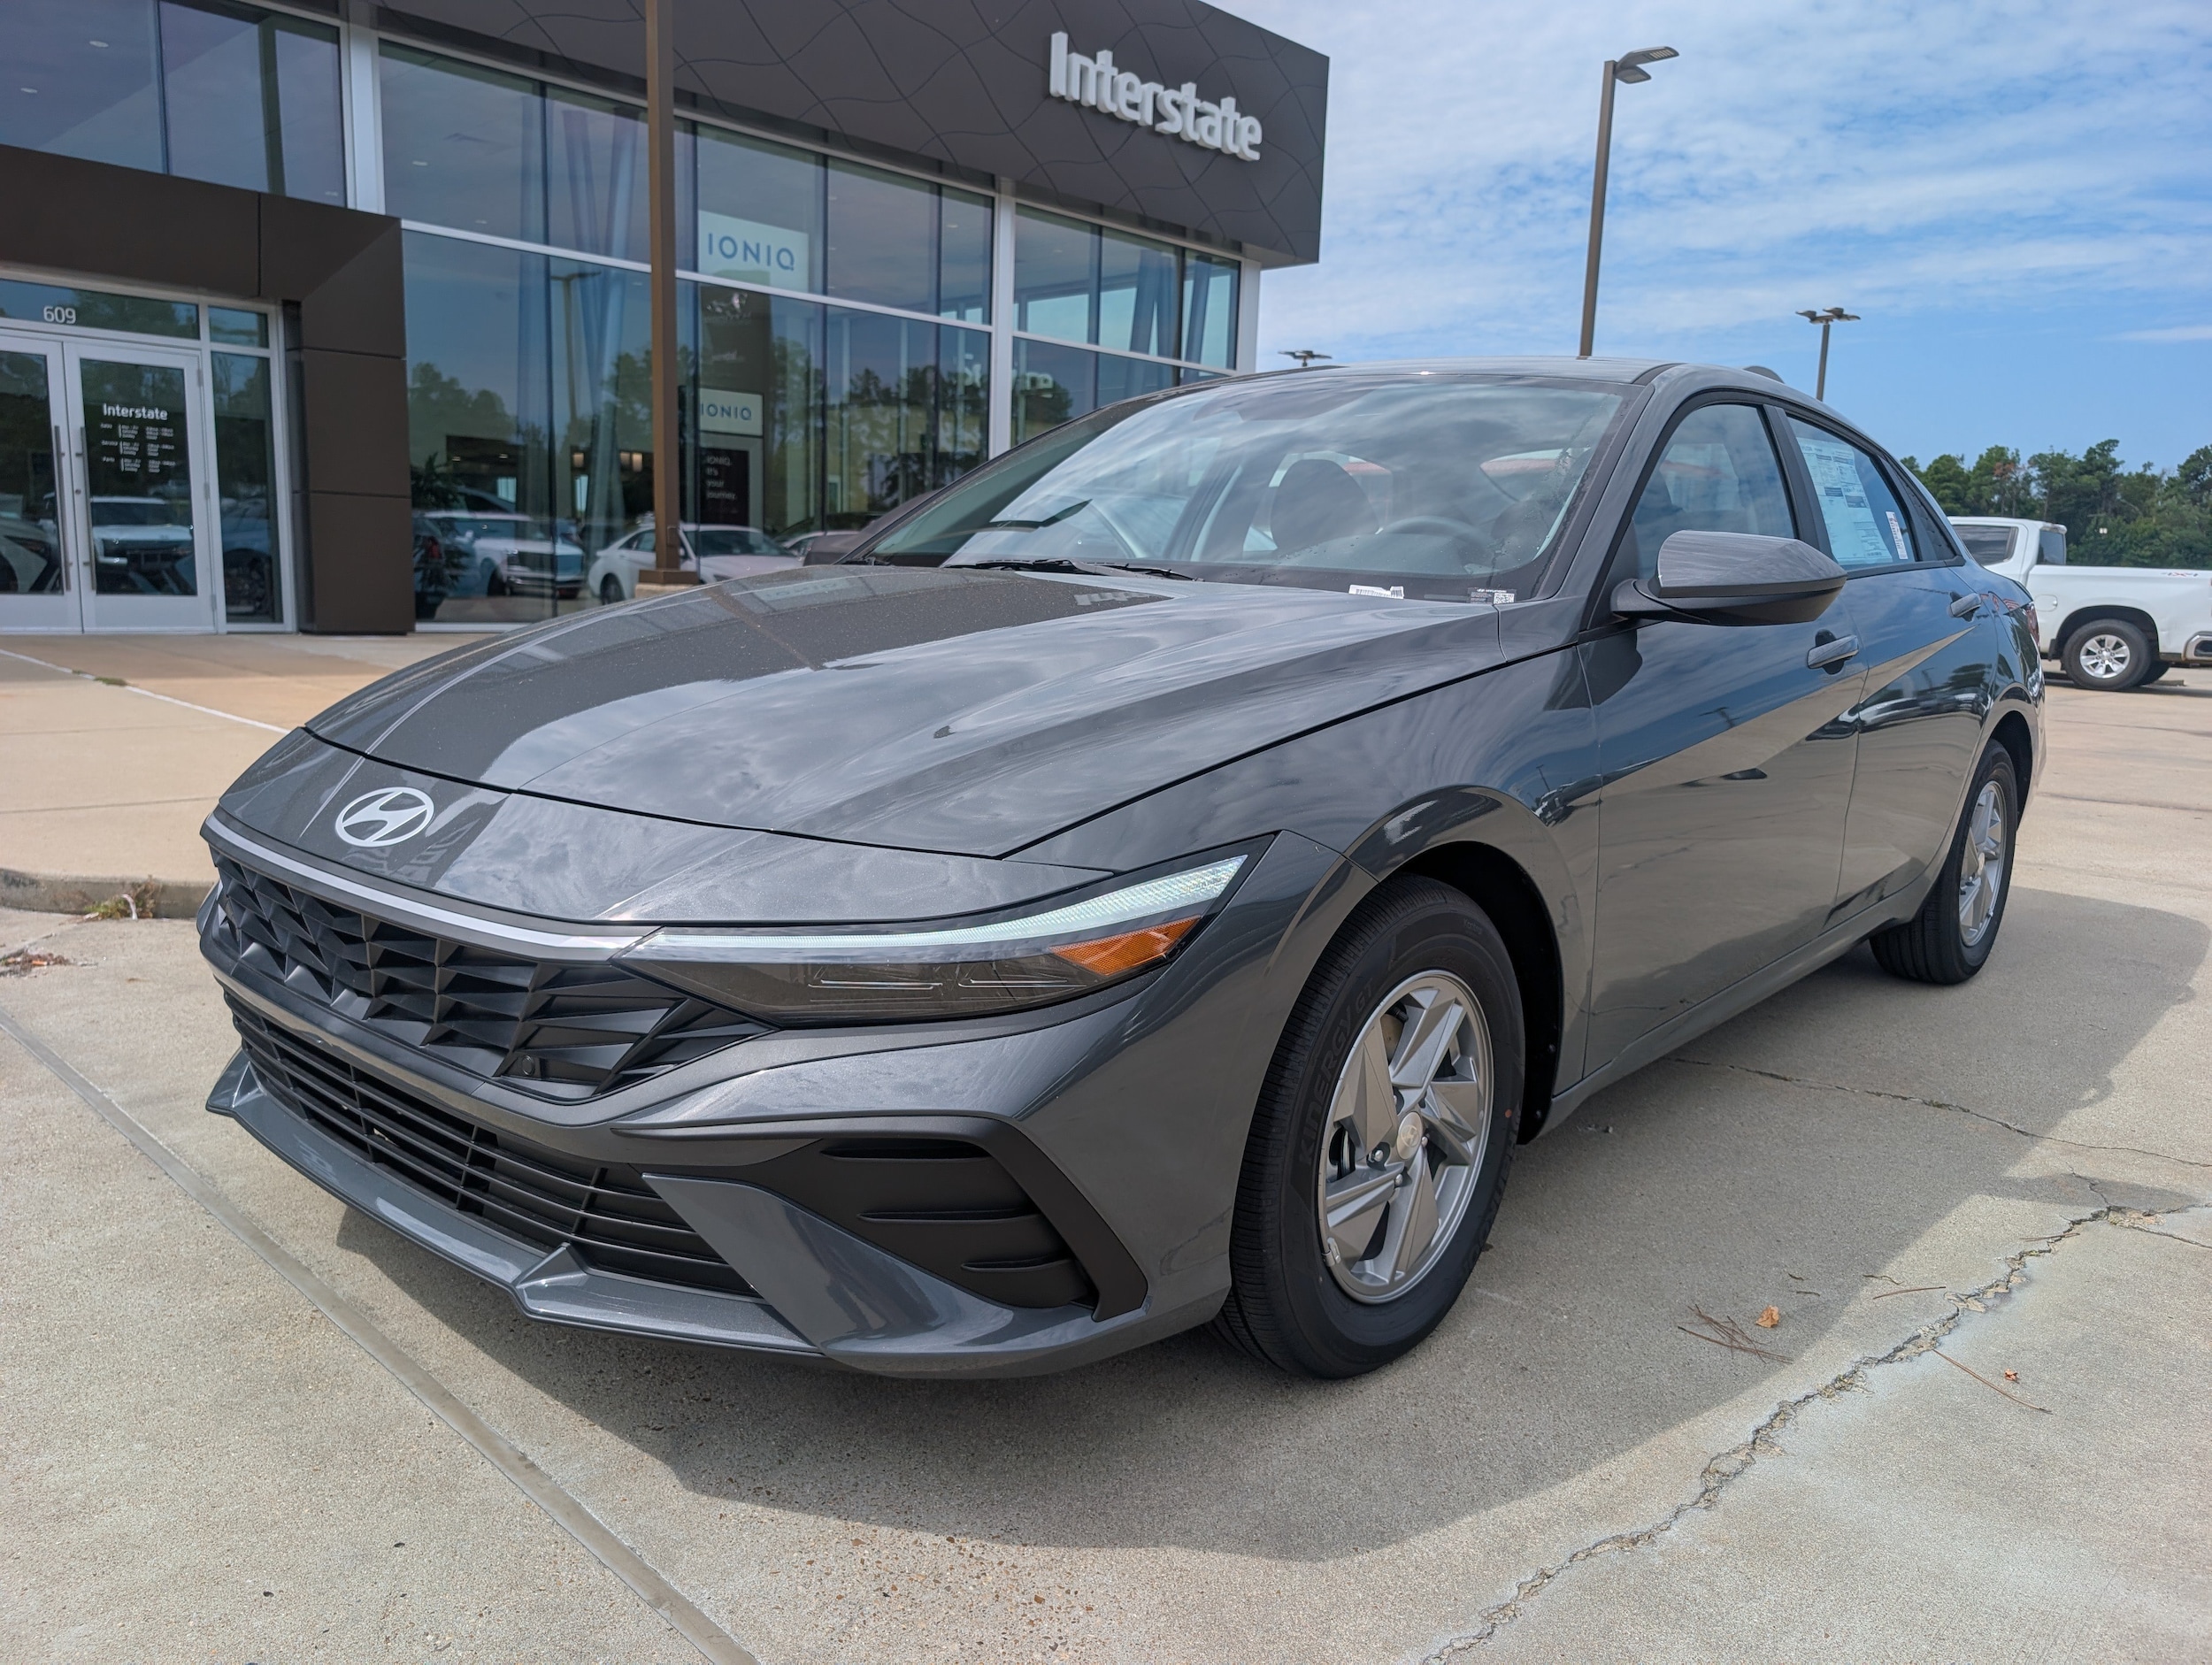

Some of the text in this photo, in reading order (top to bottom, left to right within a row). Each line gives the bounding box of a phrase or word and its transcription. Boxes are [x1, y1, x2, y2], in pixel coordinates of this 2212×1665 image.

[1049, 31, 1263, 161] Interstate
[709, 233, 795, 272] IONIQ
[43, 305, 76, 325] 609
[103, 403, 168, 420] Interstate
[702, 403, 752, 421] IONIQ
[1300, 978, 1373, 1166] KINERGY GT
